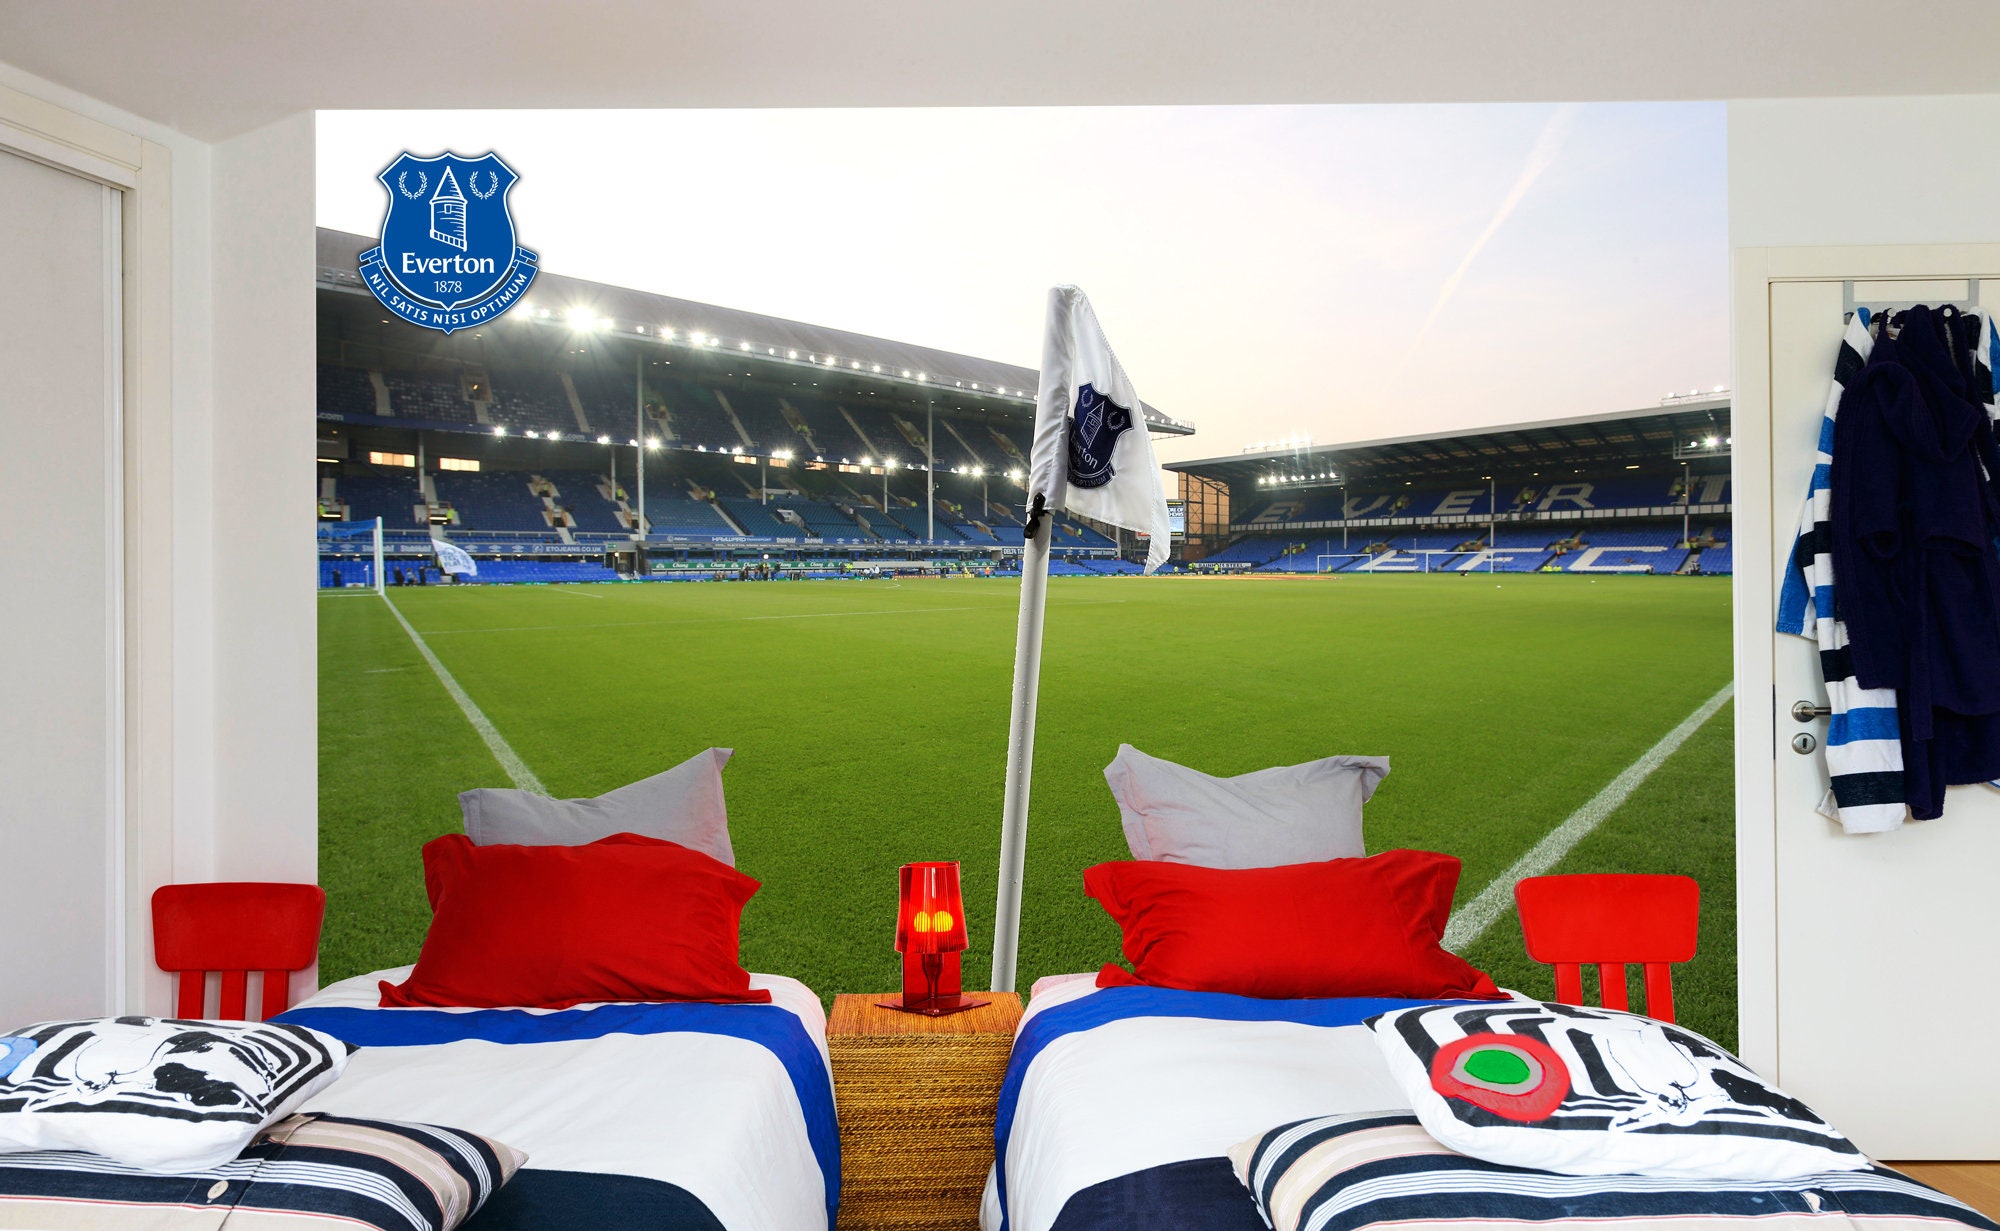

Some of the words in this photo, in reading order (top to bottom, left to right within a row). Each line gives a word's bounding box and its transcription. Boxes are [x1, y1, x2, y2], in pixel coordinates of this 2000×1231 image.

[402, 252, 495, 274] Everton
[433, 280, 462, 293] 1878
[369, 273, 389, 298] NIL
[389, 295, 429, 321] SATIS
[433, 312, 466, 325] NISI
[470, 273, 528, 320] OPTIMUM
